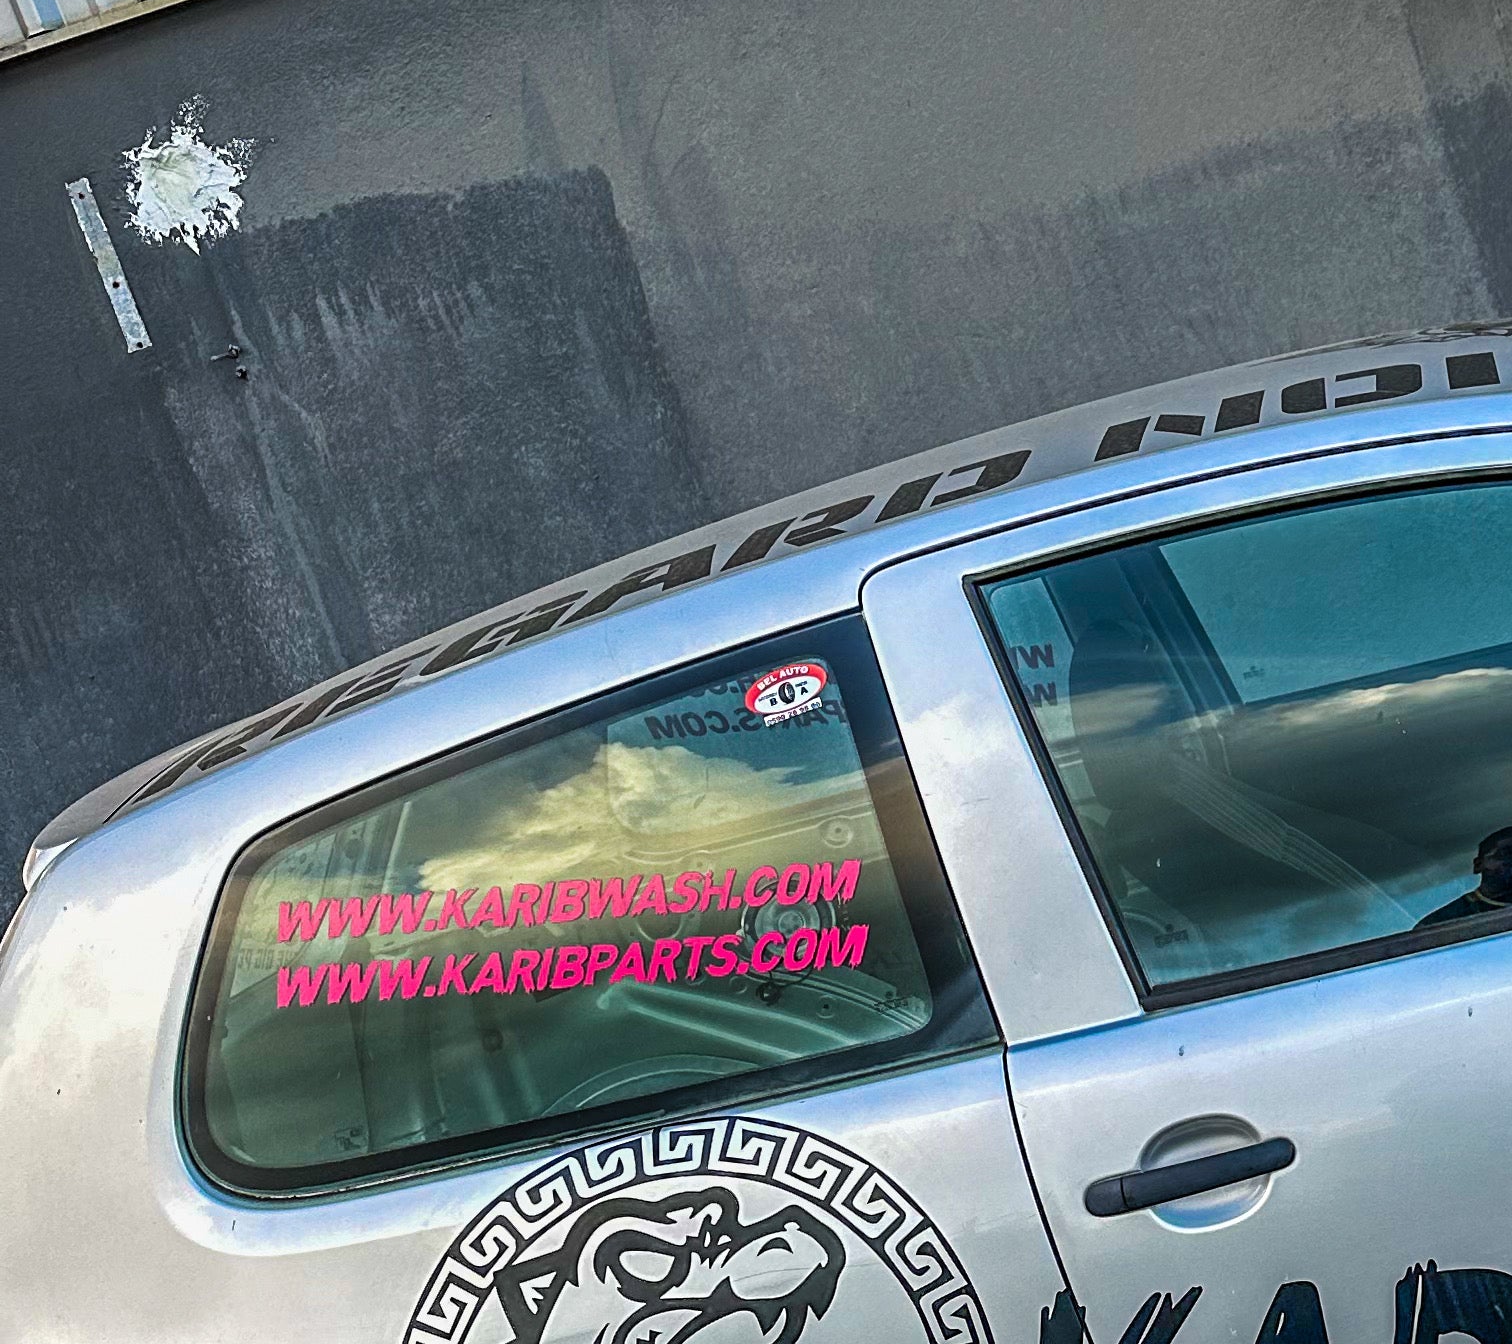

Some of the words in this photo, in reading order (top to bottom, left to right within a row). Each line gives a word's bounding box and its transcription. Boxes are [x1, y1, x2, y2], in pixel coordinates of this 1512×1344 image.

[756, 674, 778, 691] BEL
[779, 665, 809, 678] AUTO
[277, 859, 862, 943] WWW.KARIBWASH.COM
[277, 924, 869, 1009] WWW.KARIBPARTS.COM
